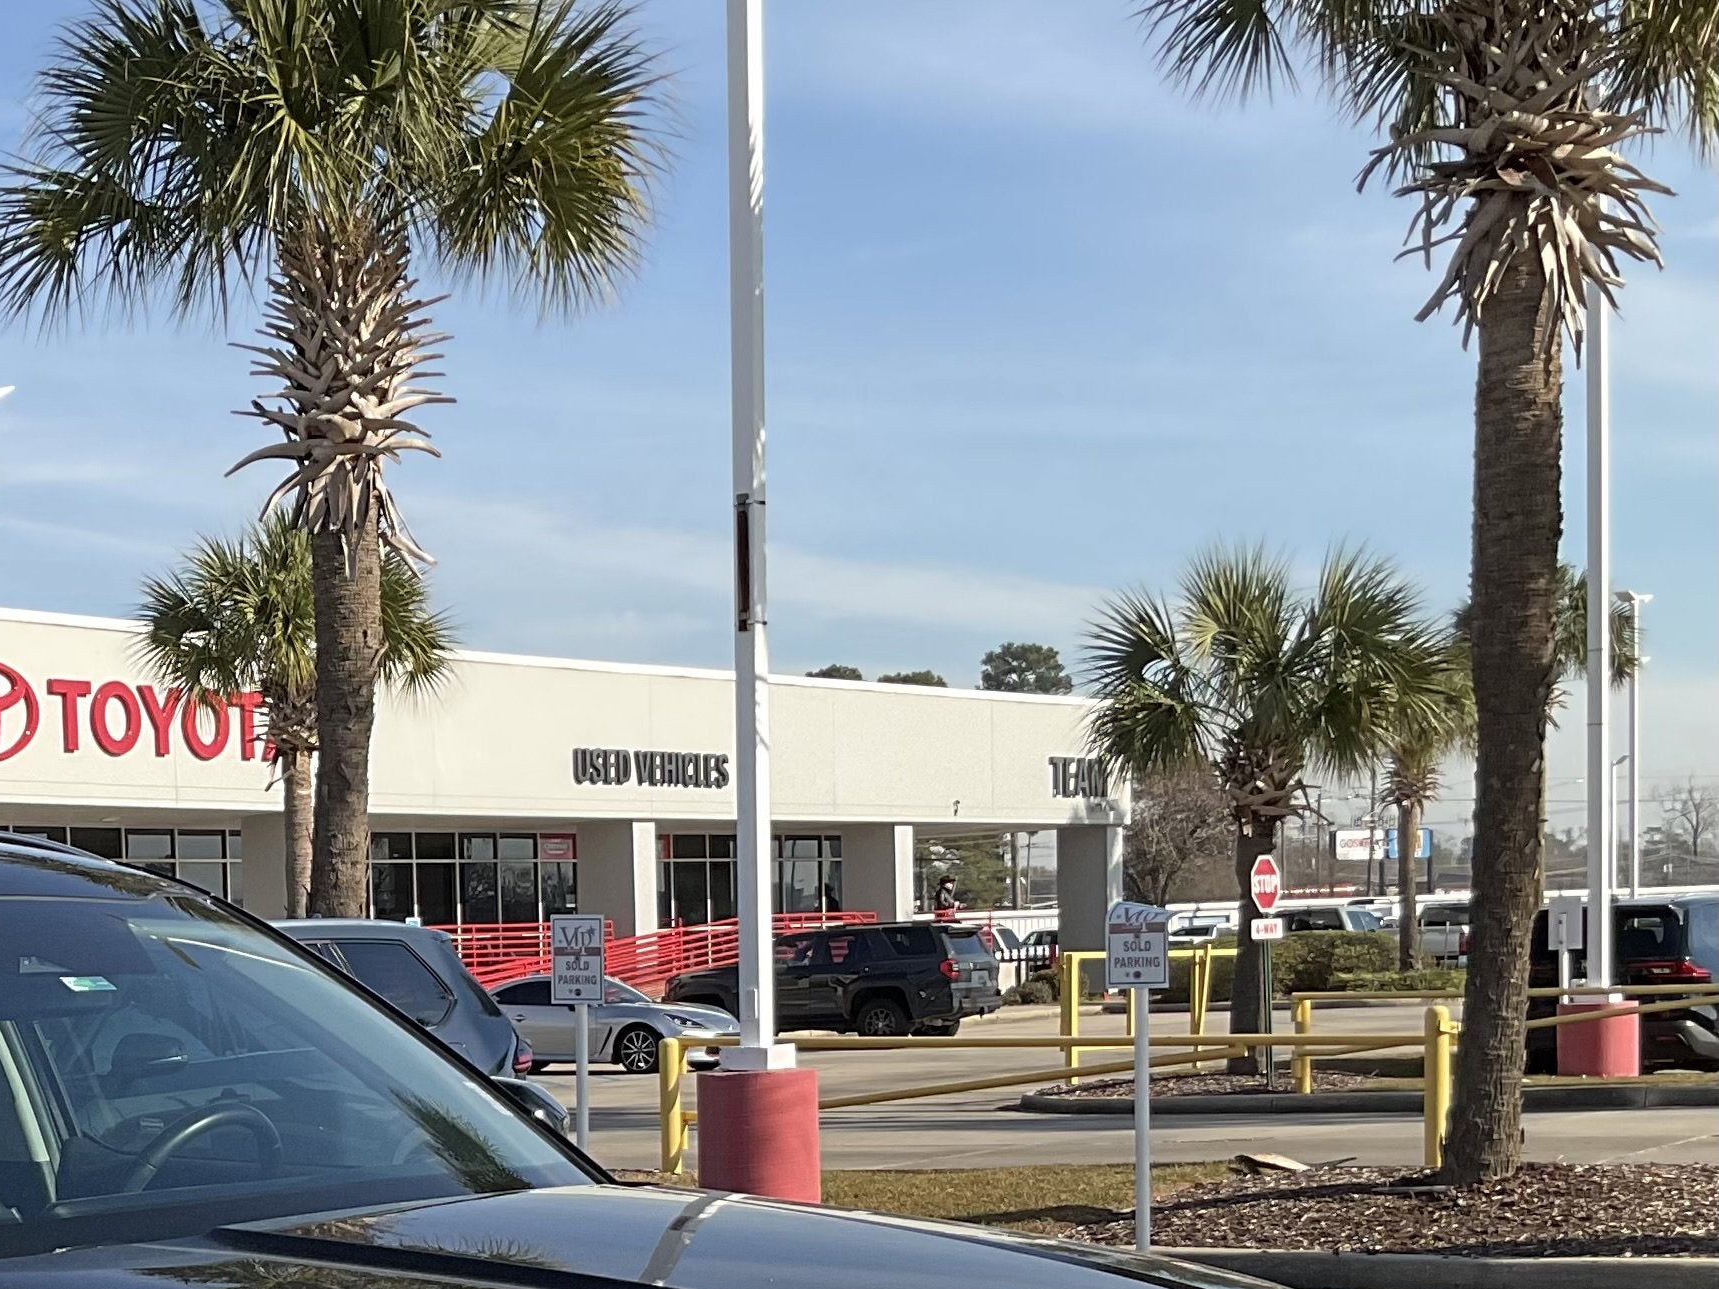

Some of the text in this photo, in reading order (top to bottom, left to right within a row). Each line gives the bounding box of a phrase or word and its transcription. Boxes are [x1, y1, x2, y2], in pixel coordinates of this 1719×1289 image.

[47, 679, 276, 762] TOYOT
[573, 748, 730, 789] USED VEHICLES
[1254, 874, 1278, 894] STOP
[1256, 924, 1277, 935] 4-WAY
[1123, 941, 1151, 952] SOLD
[565, 961, 590, 971] SOLD
[1114, 957, 1160, 968] PARKING
[558, 975, 597, 985] PARKING
